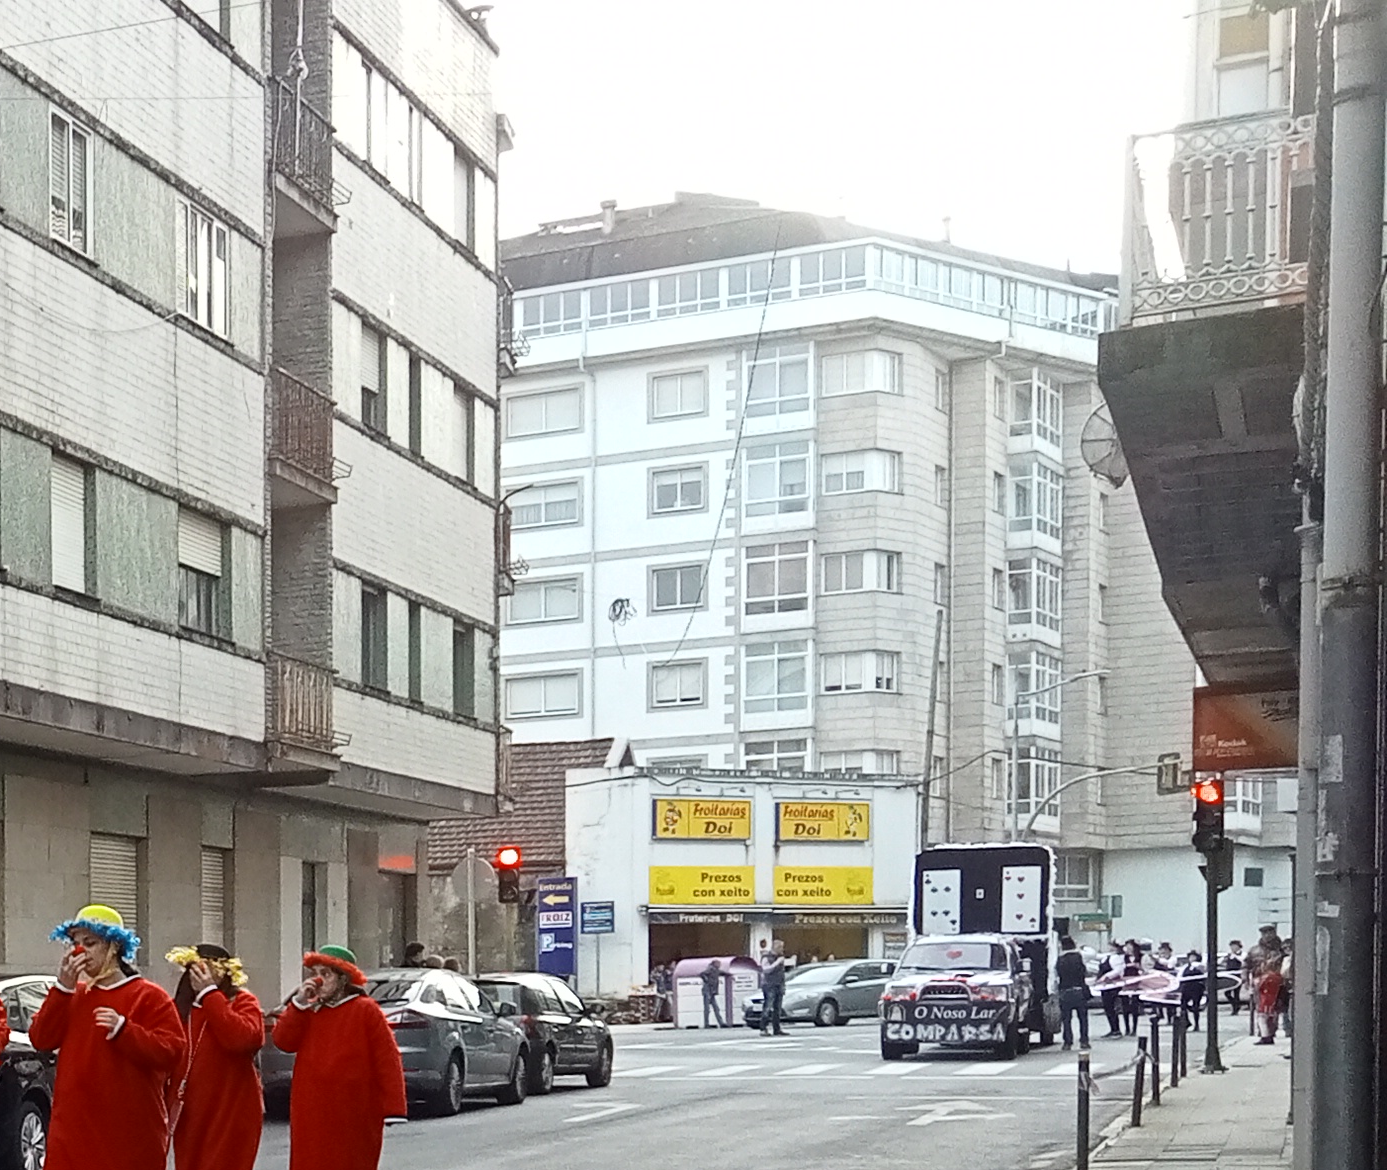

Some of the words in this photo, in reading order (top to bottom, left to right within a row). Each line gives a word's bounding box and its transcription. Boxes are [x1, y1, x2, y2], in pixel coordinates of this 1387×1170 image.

[693, 802, 747, 819] Froitarías
[783, 804, 835, 820] Froitarías
[704, 821, 733, 834] Doi
[794, 823, 821, 836] Doi
[701, 872, 742, 883] Prezos
[784, 872, 824, 883] Prezos
[693, 889, 715, 897] con
[719, 886, 750, 897] xeito
[776, 889, 798, 897] con
[801, 886, 831, 897] xeito
[838, 916, 862, 924] con
[914, 1006, 927, 1019] O
[930, 1006, 967, 1019] Noso
[971, 1006, 996, 1019] Lar
[887, 1023, 1006, 1042] COMPARSA
